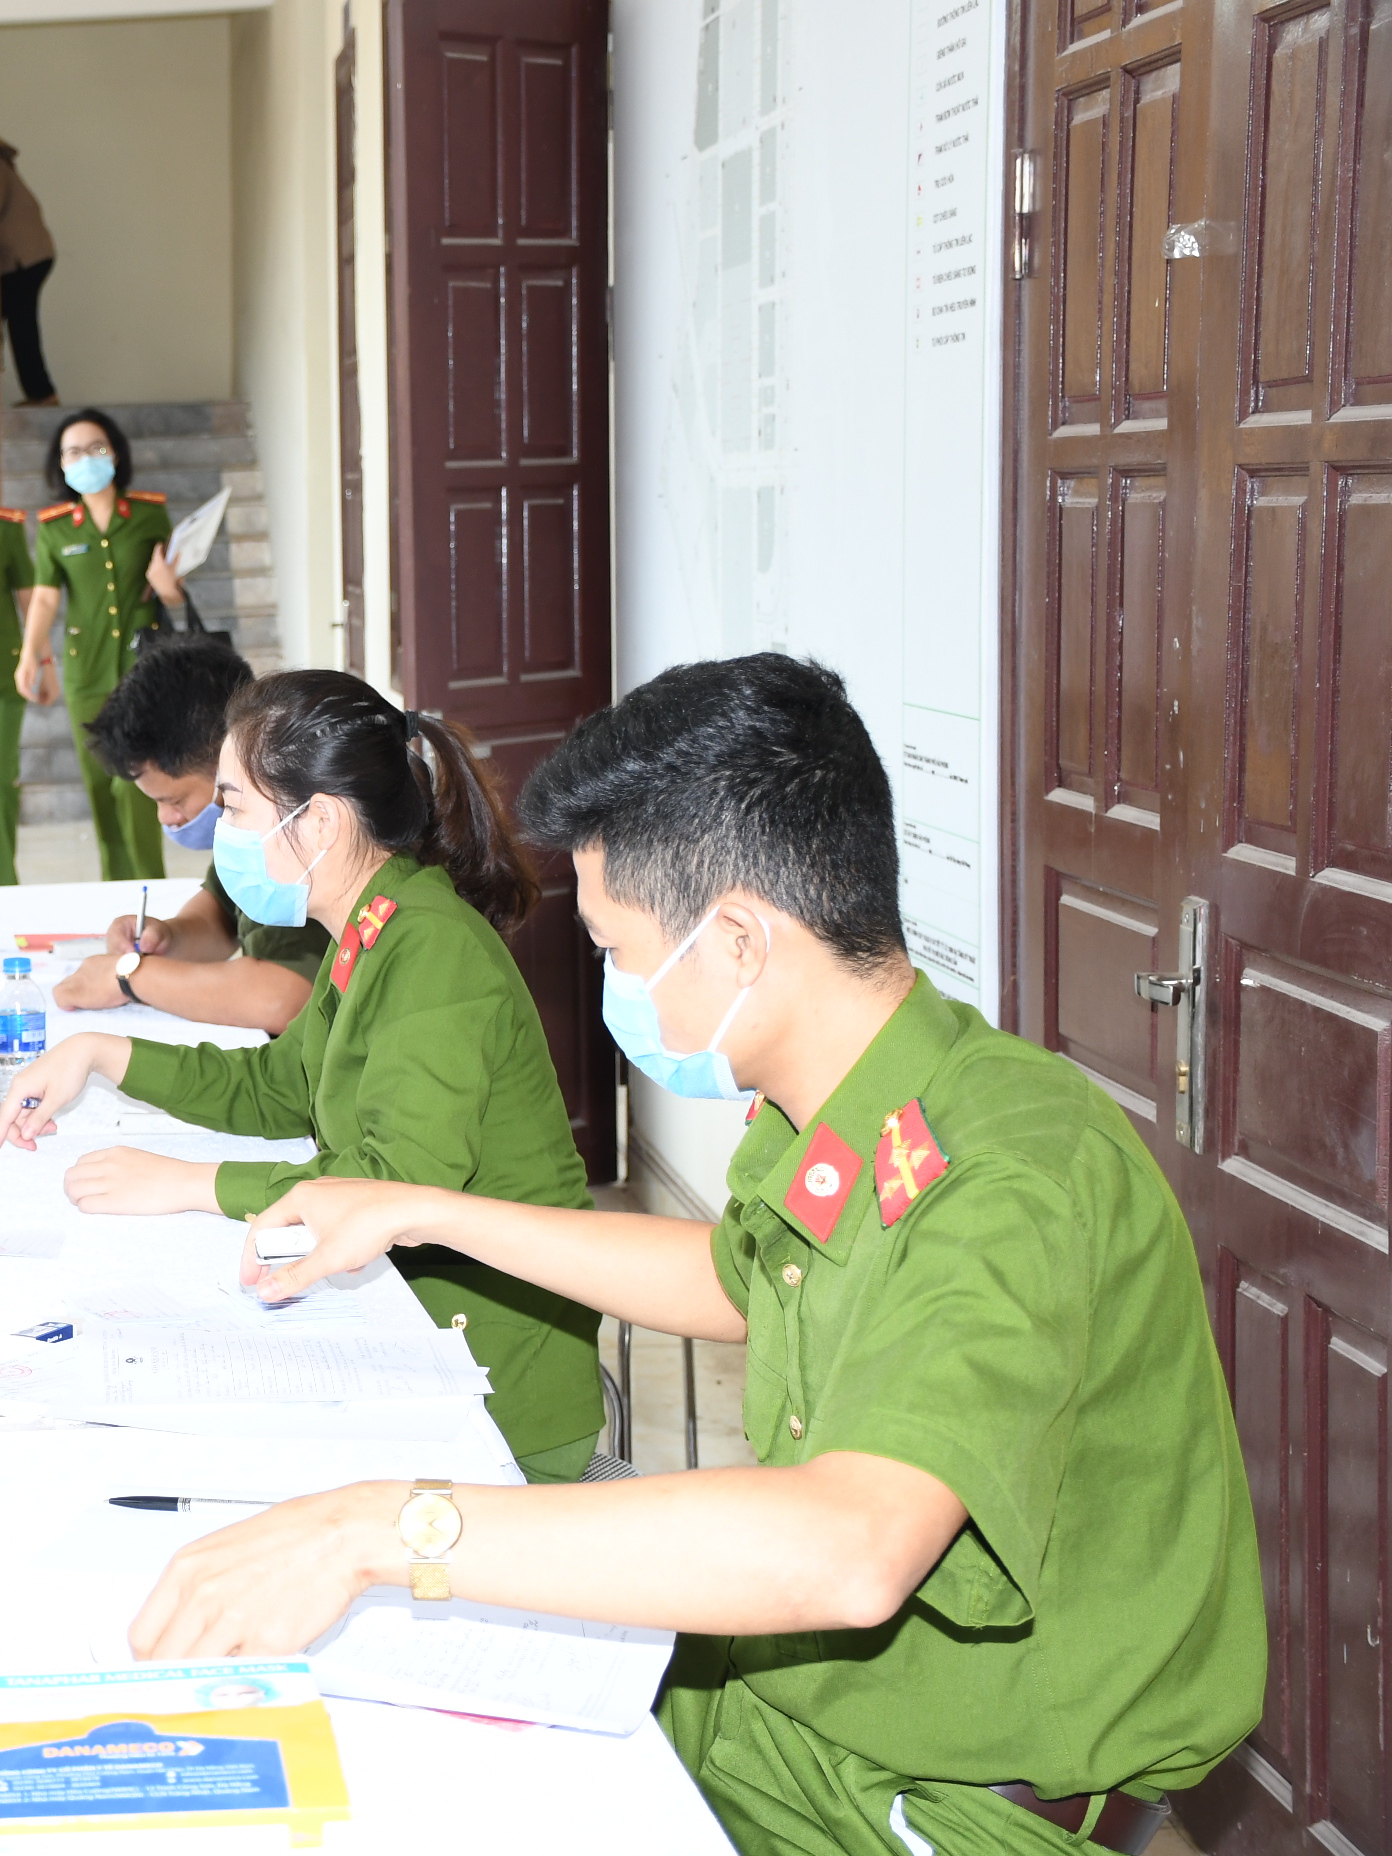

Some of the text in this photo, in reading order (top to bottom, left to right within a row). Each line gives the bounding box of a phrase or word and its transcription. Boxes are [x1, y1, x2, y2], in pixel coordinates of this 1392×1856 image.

[6, 1662, 289, 1688] TANAPHAR MEDICAL FACE MASK
[43, 1742, 175, 1758] DANAMECO
